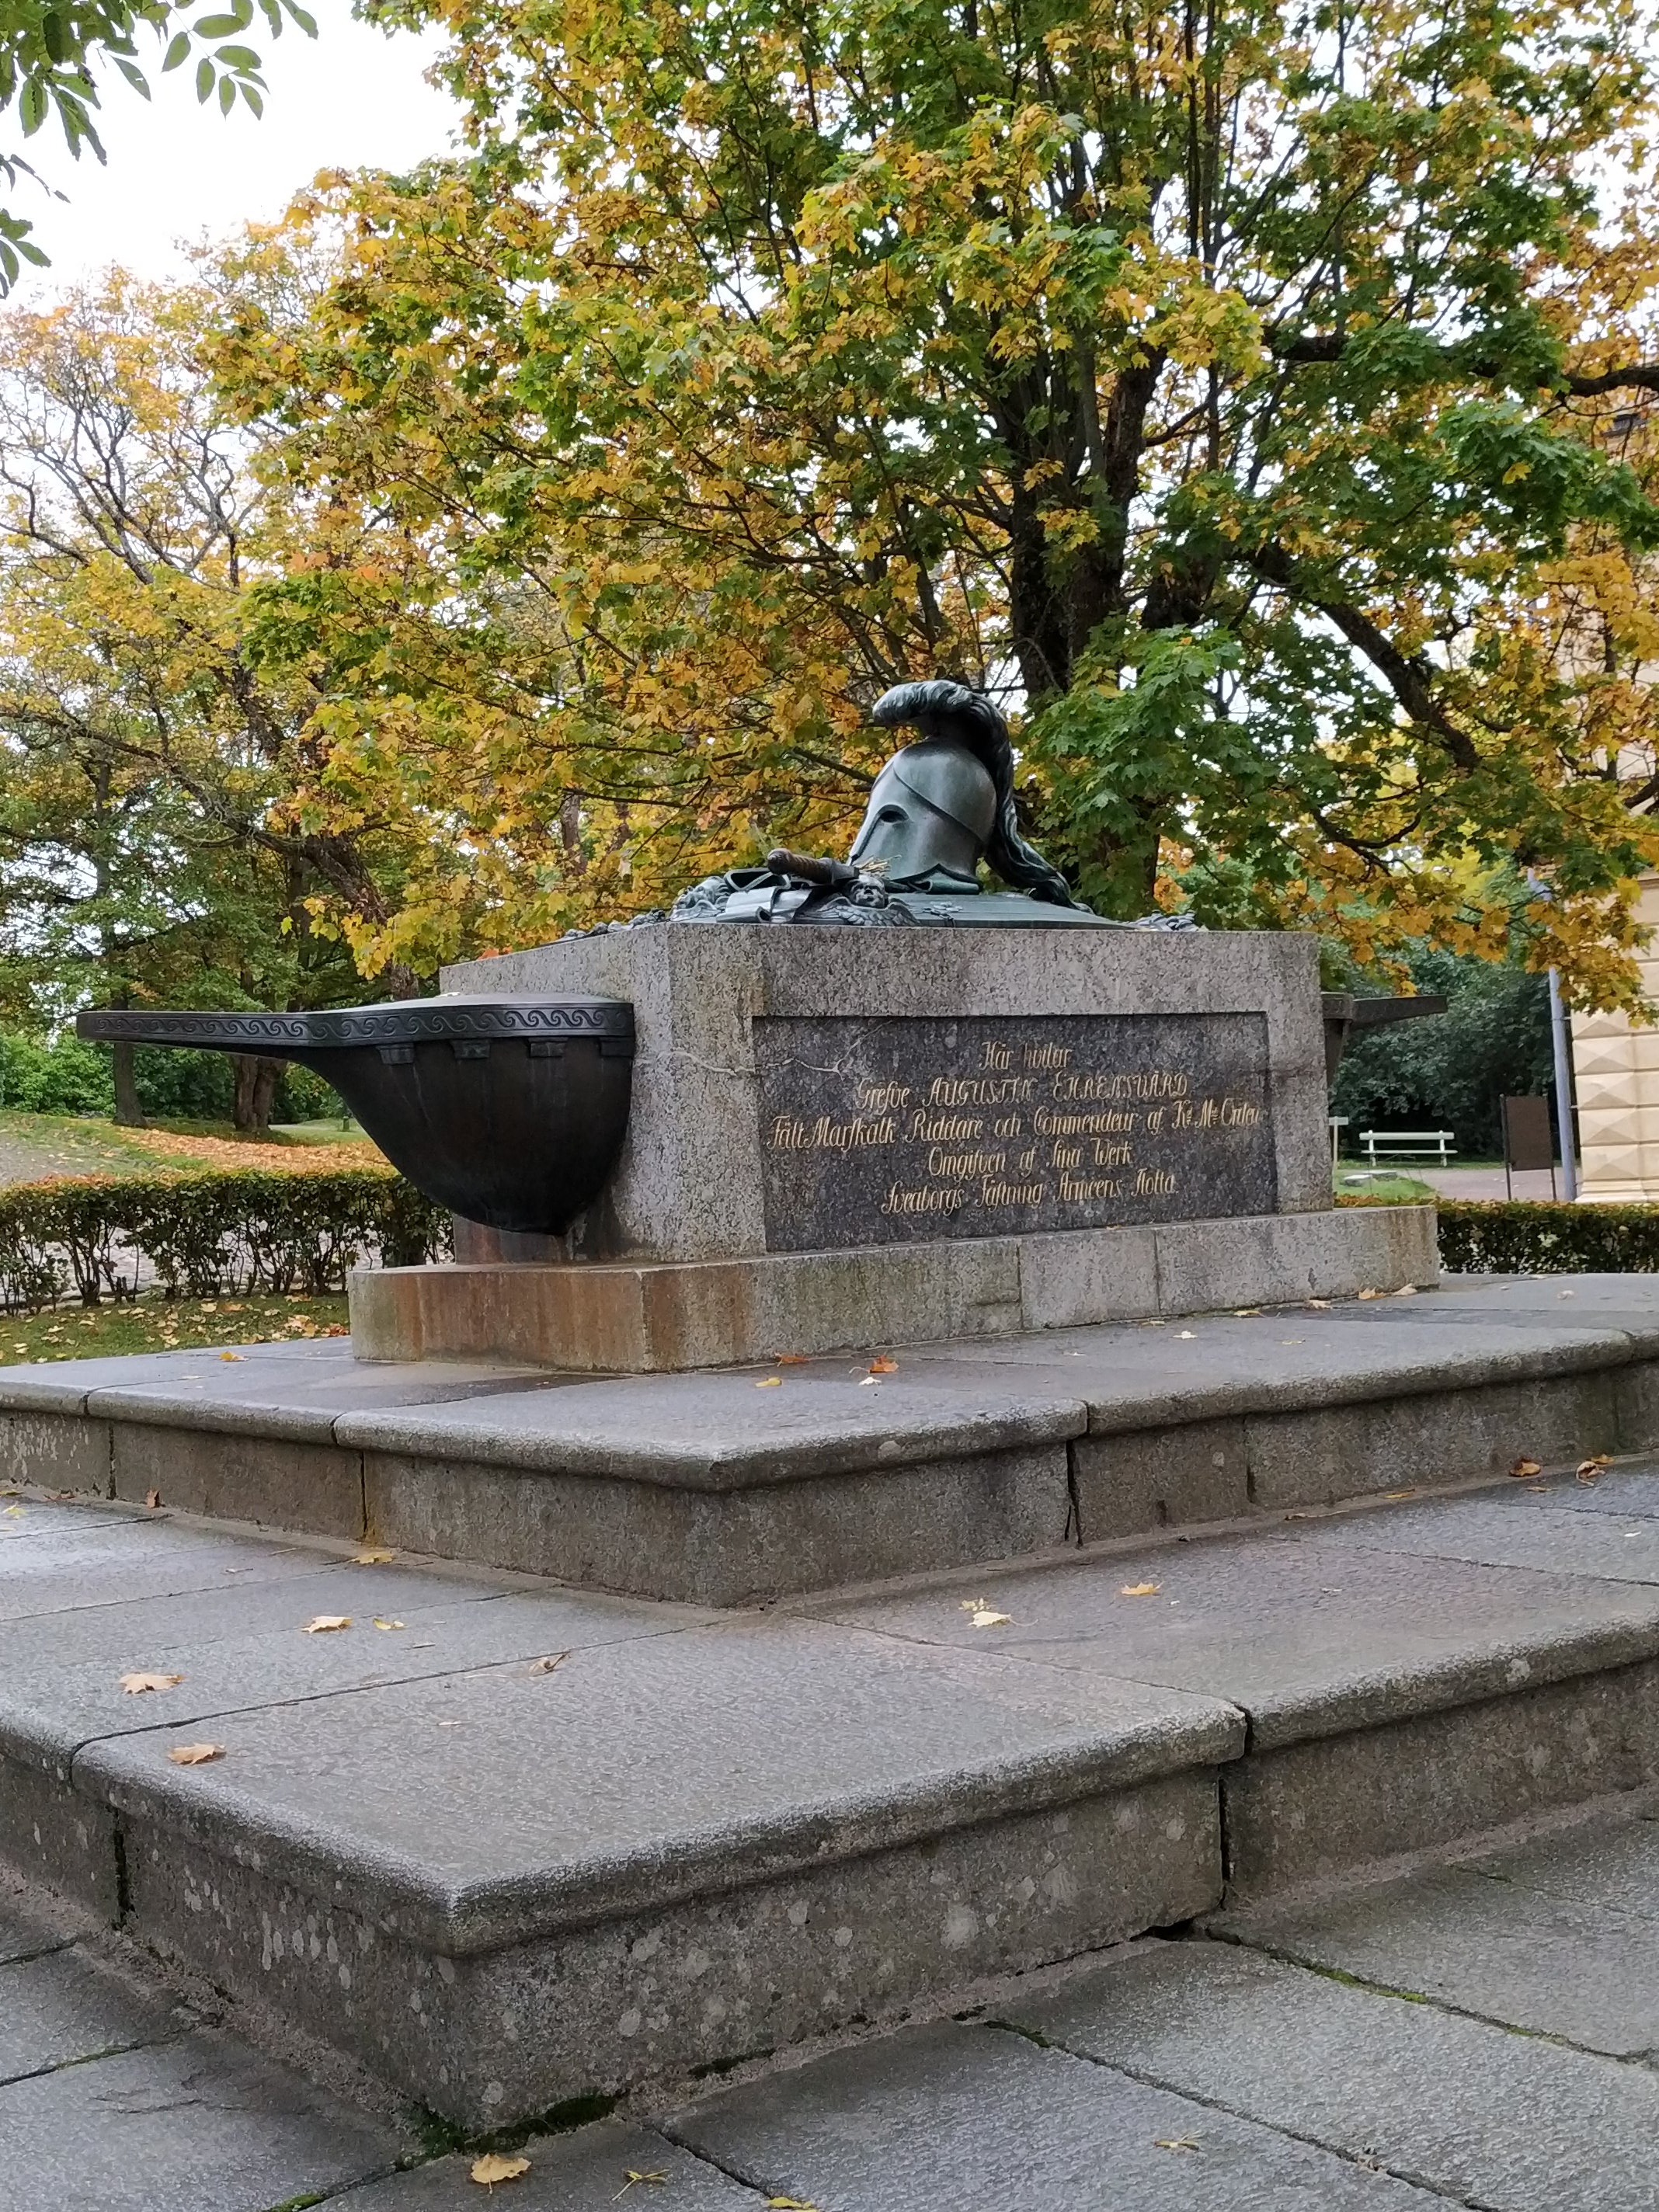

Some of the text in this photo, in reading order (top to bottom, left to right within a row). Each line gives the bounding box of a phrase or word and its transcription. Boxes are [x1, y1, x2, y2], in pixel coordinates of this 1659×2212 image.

[978, 1041, 1014, 1071] Här
[922, 1076, 1038, 1108] AUGUSTIN
[1052, 1069, 1188, 1103] EHRENSVÄRD
[904, 1108, 983, 1143] Riddare
[993, 1111, 1022, 1138] och
[1033, 1104, 1143, 1136] Commendeur
[1146, 1105, 1167, 1136] af
[928, 1146, 1006, 1181] Omgifven
[1019, 1145, 1039, 1178] af
[1089, 1137, 1133, 1166] Werk
